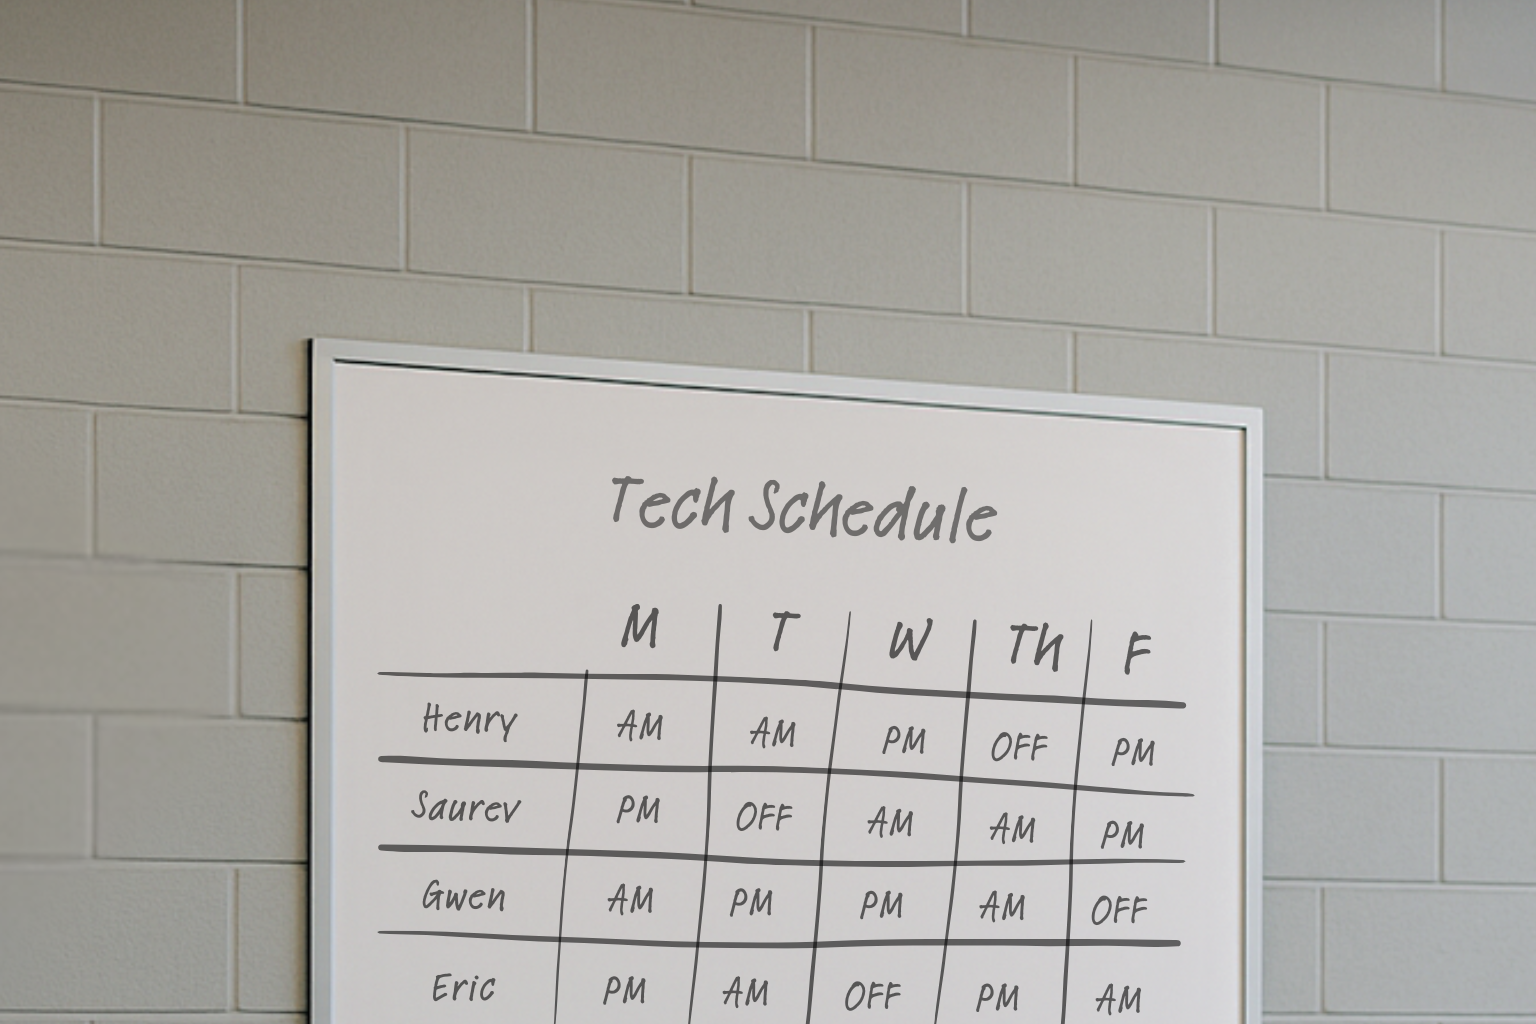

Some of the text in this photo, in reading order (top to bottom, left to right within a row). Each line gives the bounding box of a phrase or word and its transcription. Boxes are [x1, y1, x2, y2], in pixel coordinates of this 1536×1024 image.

[610, 475, 998, 544] Tech Schedule
[620, 603, 1152, 676] M T W Th F
[422, 701, 1156, 767] Henry AM AM PM OFF PM
[410, 789, 1145, 850] Saurev PM OFF AM AM PM
[422, 878, 1148, 926] Gwen AM PM PM AM OFF
[432, 972, 1142, 1016] Eric PM AM OFF PM AM
